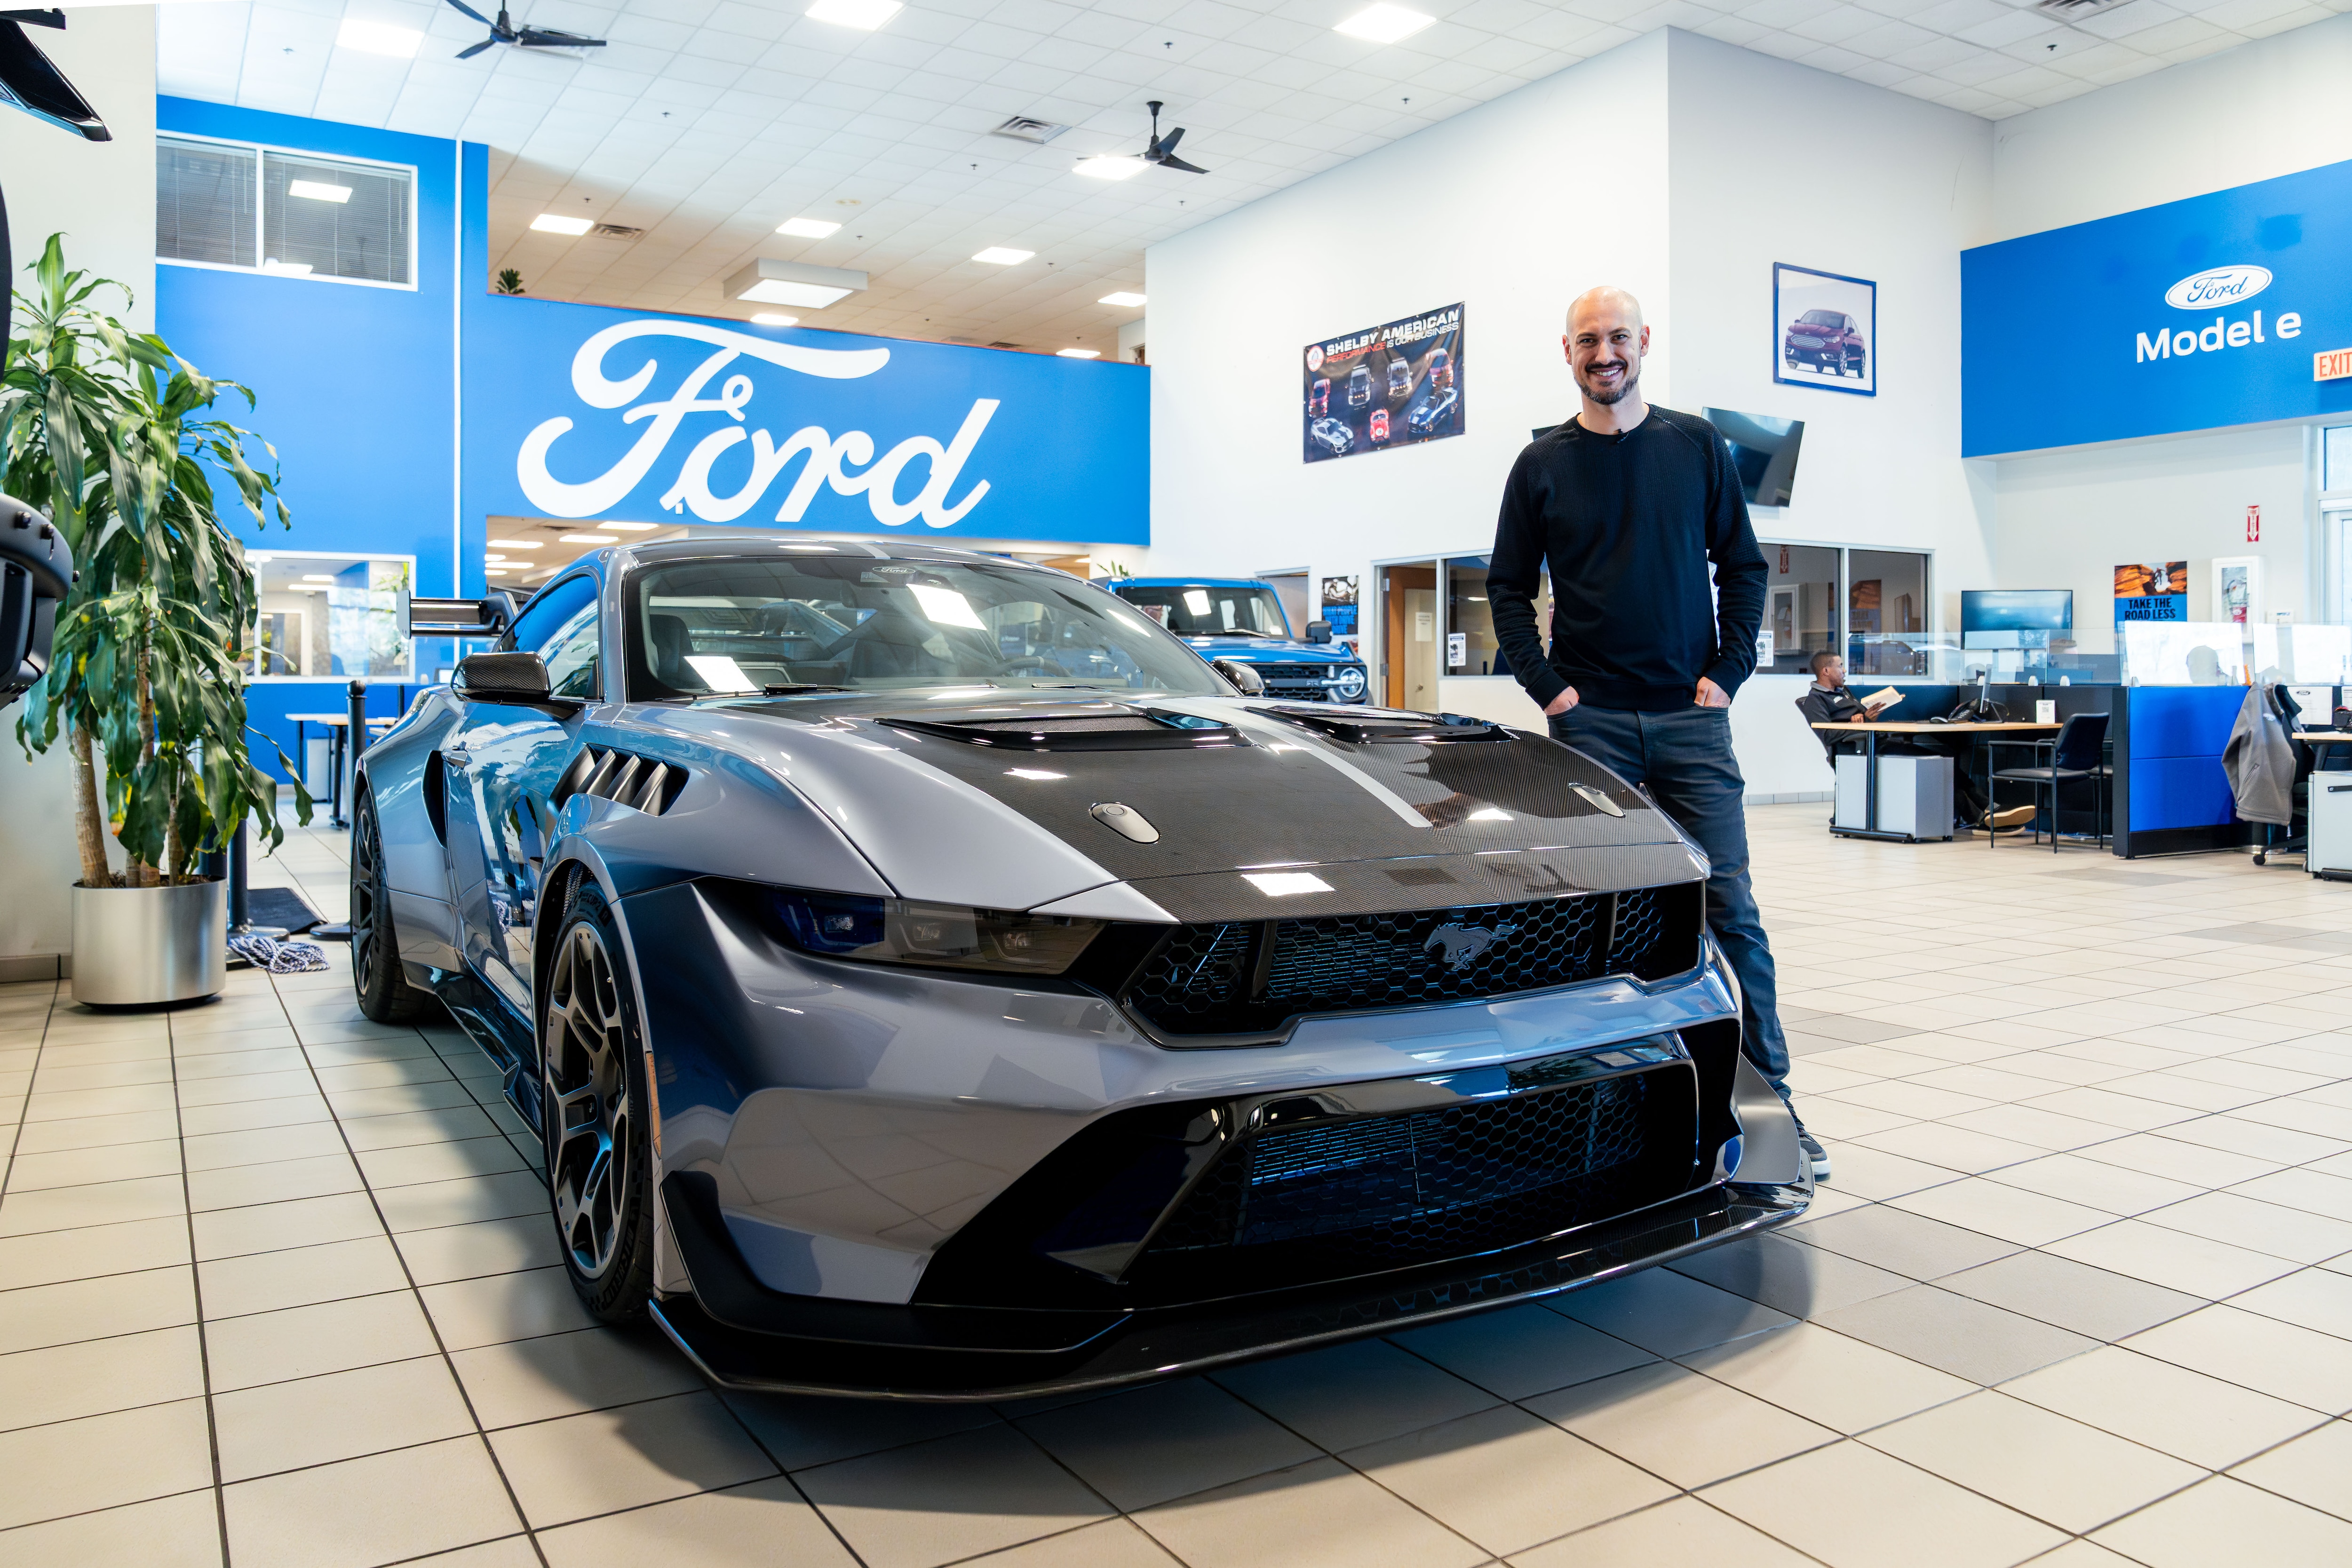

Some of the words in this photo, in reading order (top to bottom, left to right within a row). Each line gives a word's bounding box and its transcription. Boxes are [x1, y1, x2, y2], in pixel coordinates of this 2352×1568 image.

[2187, 274, 2249, 303] Ford
[1326, 331, 1379, 356] SHELBY
[1381, 309, 1459, 342] AMERICAN
[1386, 339, 1394, 348] IS
[1414, 321, 1459, 341] BUSINESS
[2136, 310, 2265, 363] Model
[2275, 312, 2302, 339] e
[2319, 352, 2352, 377] EXIT
[517, 319, 1001, 528] Ford
[2125, 610, 2150, 620] ROAD
[2153, 609, 2176, 619] LESS
[2129, 599, 2152, 609] TAKE
[2154, 597, 2172, 608] THE
